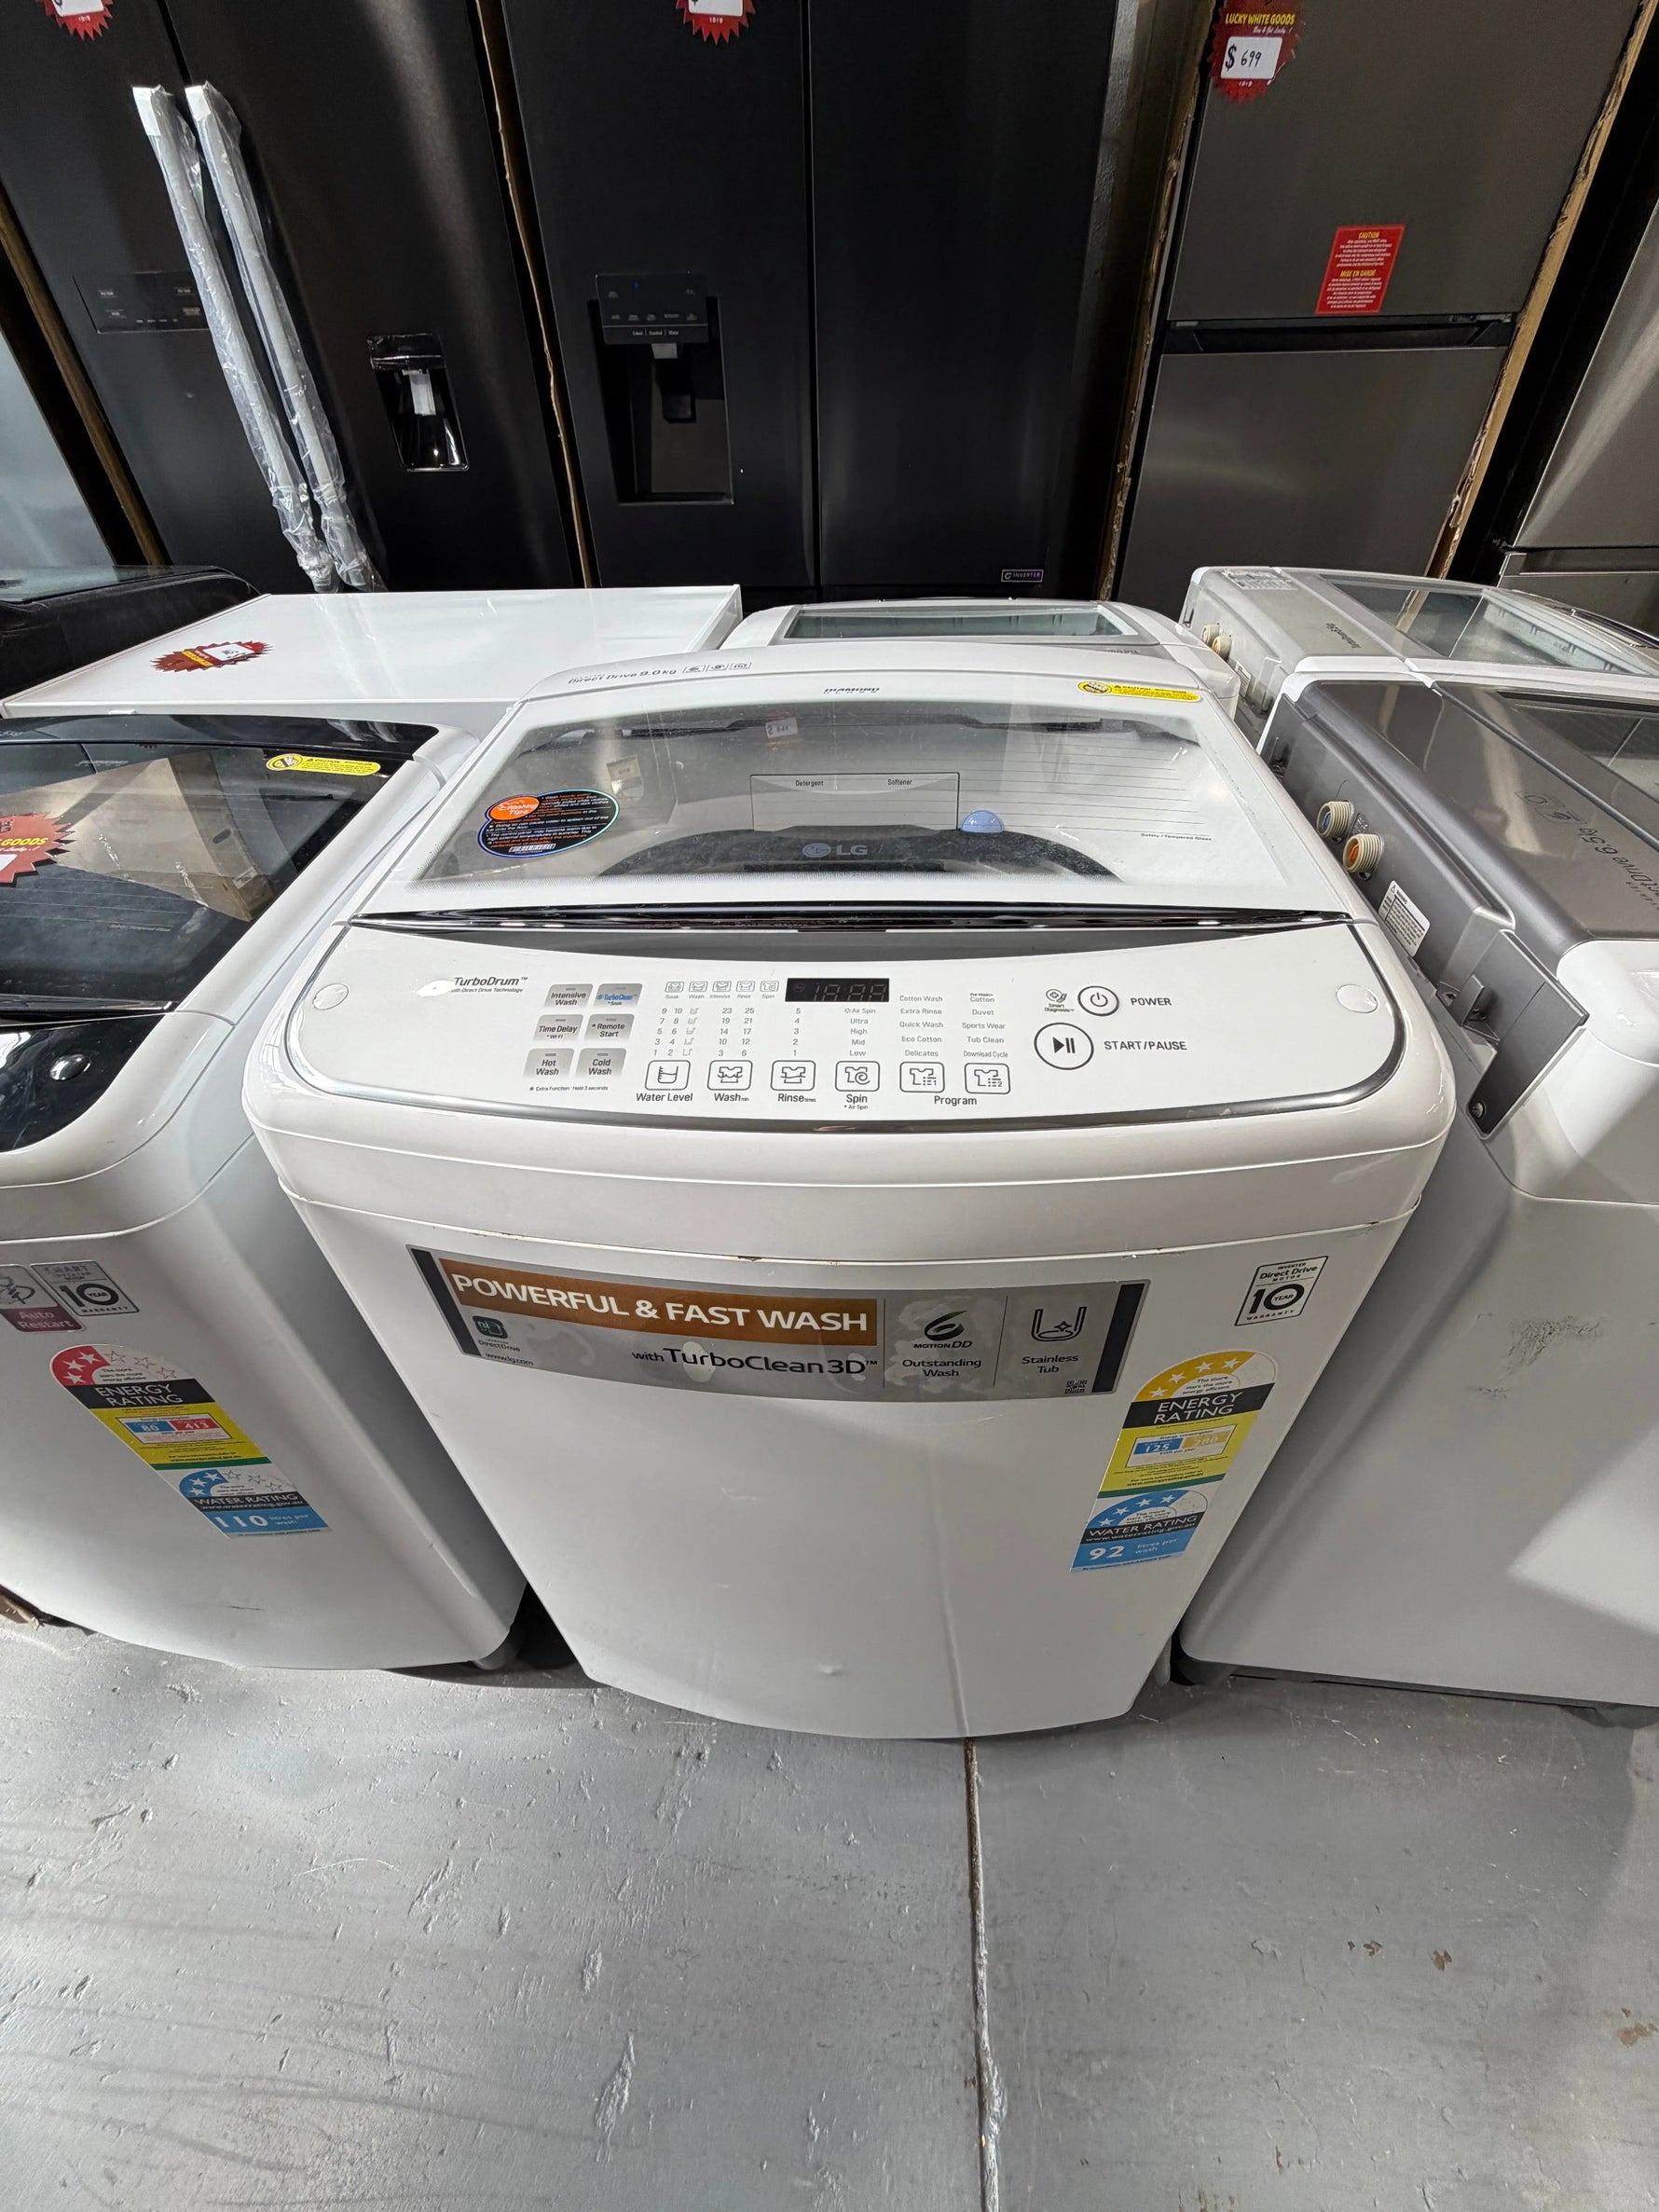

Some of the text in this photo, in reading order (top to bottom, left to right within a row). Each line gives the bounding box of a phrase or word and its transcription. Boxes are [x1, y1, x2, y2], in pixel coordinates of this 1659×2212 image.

[1225, 13, 1296, 24] LUCKY WHITE GOODS
[1225, 43, 1262, 72] $ 699
[568, 675, 604, 684] Direct
[795, 779, 824, 788] Detergent
[0, 837, 48, 846] GOODS
[835, 845, 868, 856] LG
[1130, 997, 1172, 1006] POWER
[556, 1025, 578, 1035] Delay
[962, 1022, 985, 1030] Sports
[1104, 1040, 1187, 1051] START/PAUSE
[992, 1051, 1008, 1059] Cycle
[636, 1093, 693, 1102] Water Level
[713, 1093, 741, 1102] Wash
[777, 1093, 804, 1103] Rinse
[845, 1093, 868, 1105] Spin
[934, 1095, 978, 1106] Program
[1277, 1262, 1307, 1271] INVERTER
[1259, 1266, 1318, 1280] Direct Drive
[59, 1283, 119, 1308] 10
[1249, 1284, 1305, 1314] 10
[451, 1273, 867, 1331] POWERFUL & FAST WASH
[19, 1312, 55, 1320] Auto
[1246, 1309, 1295, 1321] WARRANTY
[17, 1320, 75, 1329] Restart
[952, 1340, 973, 1349] DD
[632, 1351, 665, 1363] with
[663, 1347, 824, 1374] TurboClean
[902, 1357, 981, 1368] Outstanding
[1021, 1354, 1079, 1365] Stainless
[923, 1368, 959, 1377] Wash
[1036, 1364, 1059, 1374] Tub
[94, 1383, 171, 1397] ENERGY
[105, 1394, 184, 1407] RATING
[1157, 1392, 1243, 1413] ENERGY
[1153, 1404, 1235, 1424] RATING
[1145, 1443, 1171, 1453] 125
[194, 1493, 298, 1505] WATER RATING
[213, 1515, 268, 1528] 110
[1089, 1516, 1198, 1537] WATER RATING
[1089, 1546, 1125, 1560] 92
[1134, 1546, 1158, 1555] wash
